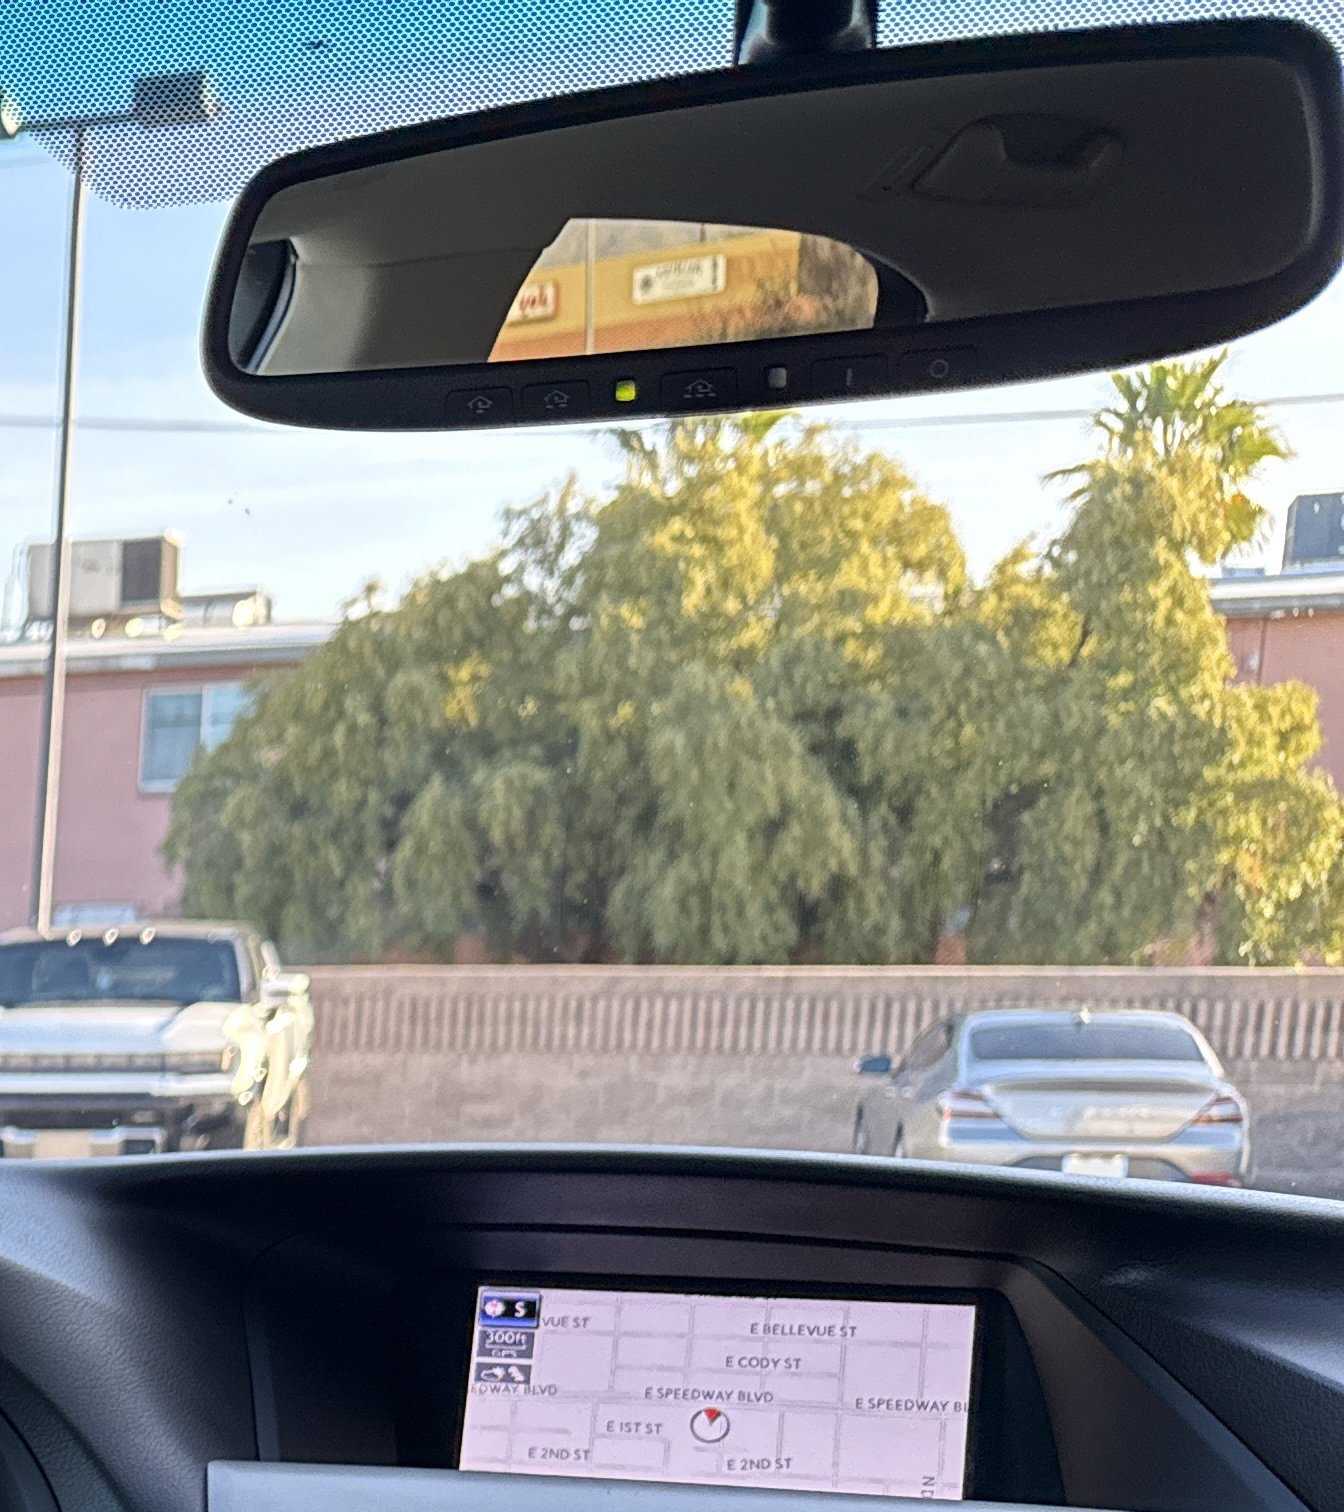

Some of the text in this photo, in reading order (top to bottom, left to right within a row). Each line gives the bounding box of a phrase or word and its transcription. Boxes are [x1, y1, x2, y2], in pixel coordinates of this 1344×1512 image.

[572, 1317, 590, 1329] ST
[750, 1322, 857, 1339] E BELLEVUE ST
[725, 1356, 802, 1371] E CODY ST
[644, 1386, 774, 1403] E SPEEDWAY BLVD
[855, 1397, 864, 1409] E
[868, 1398, 949, 1412] SPEEDWAY
[607, 1420, 615, 1433] E
[646, 1423, 662, 1435] ST
[528, 1447, 591, 1461] E 2ND ST
[727, 1457, 792, 1471] E 2ND ST
